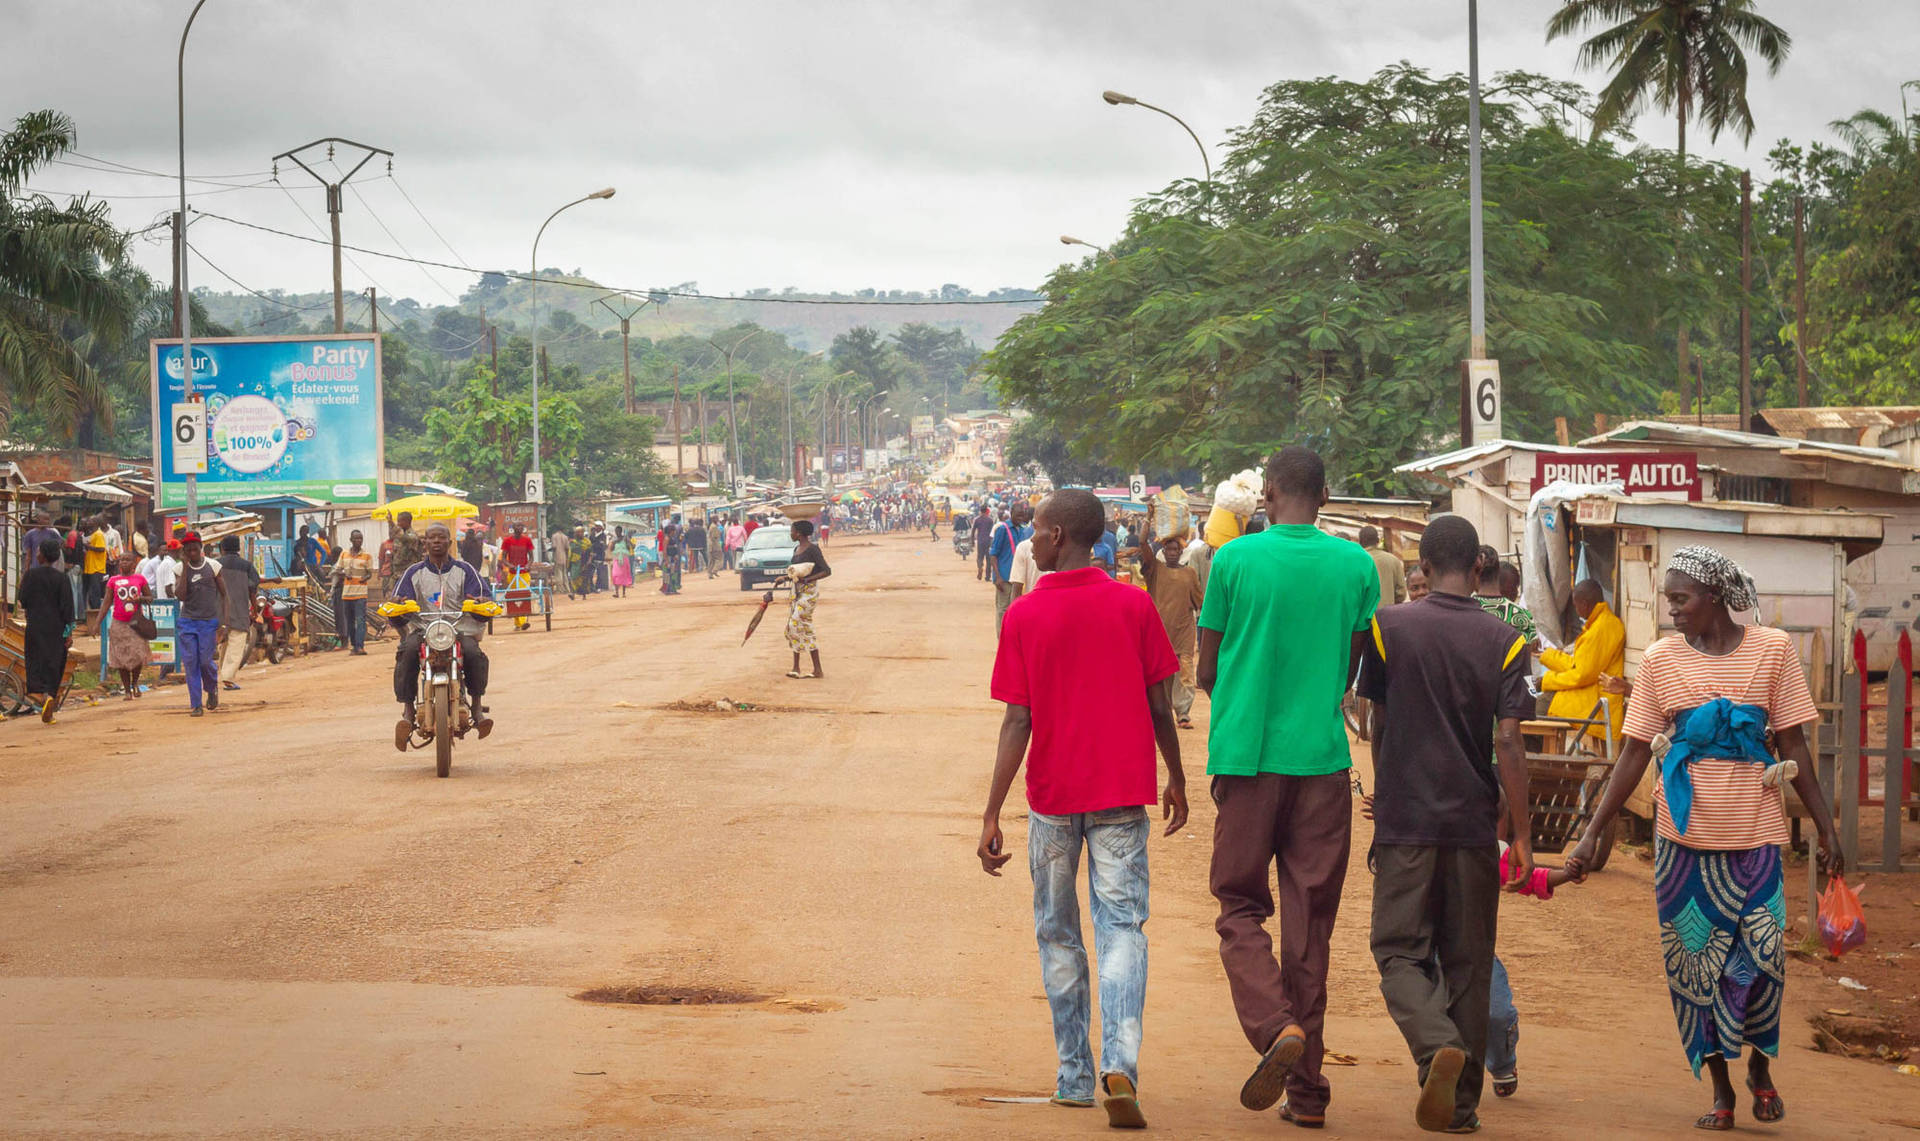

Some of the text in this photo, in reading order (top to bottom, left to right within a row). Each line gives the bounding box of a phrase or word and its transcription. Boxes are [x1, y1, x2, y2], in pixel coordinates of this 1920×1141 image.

[172, 356, 209, 370] aur
[313, 345, 369, 369] Party
[292, 362, 357, 382] Bonus
[1477, 378, 1496, 422] 6
[175, 415, 195, 443] 6
[230, 436, 272, 450] 100%
[1544, 463, 1620, 485] PRINCE
[528, 479, 537, 496] 6
[736, 479, 743, 488] 6
[1132, 481, 1141, 494] 6
